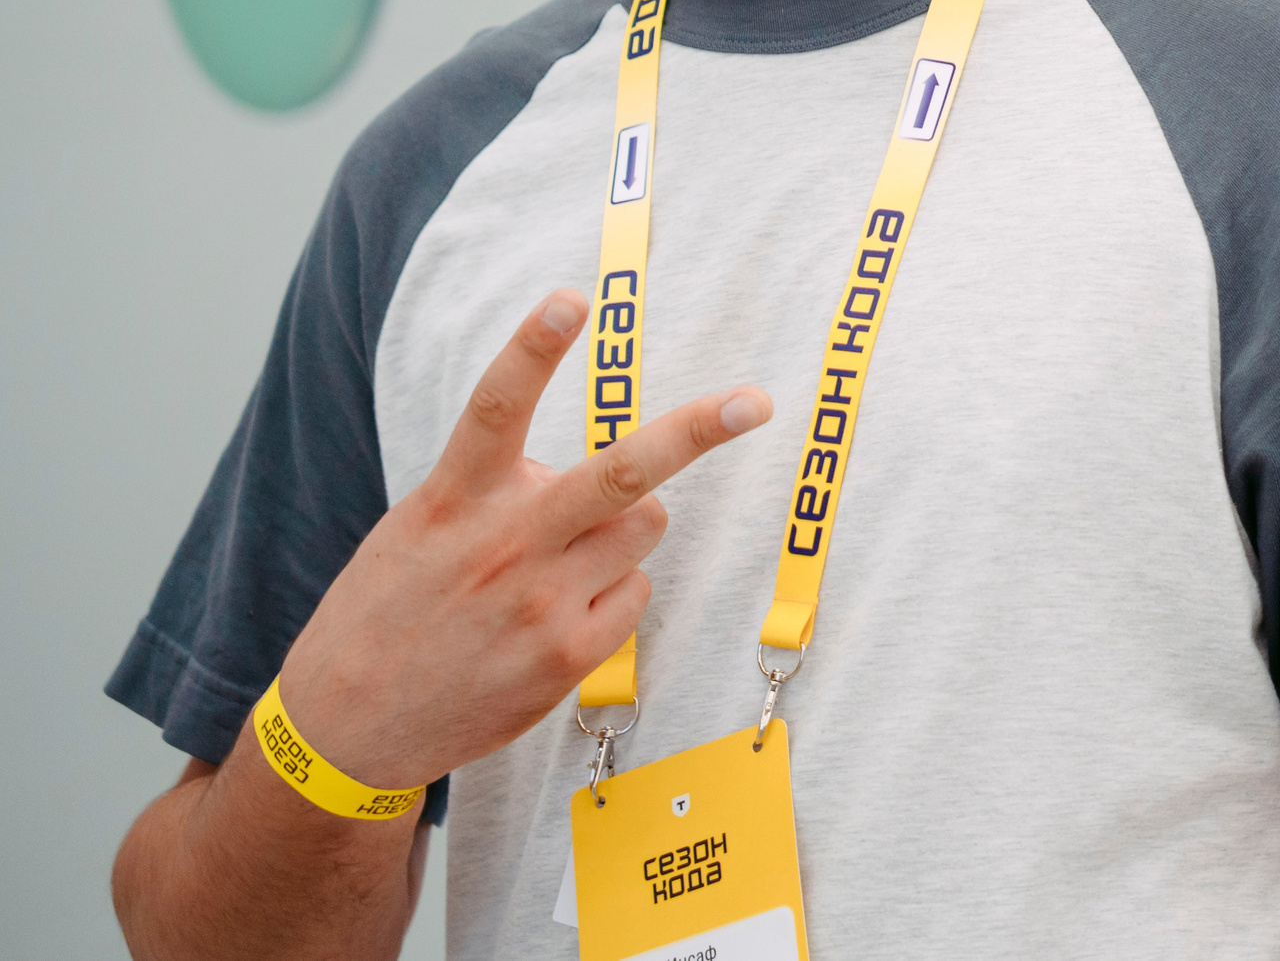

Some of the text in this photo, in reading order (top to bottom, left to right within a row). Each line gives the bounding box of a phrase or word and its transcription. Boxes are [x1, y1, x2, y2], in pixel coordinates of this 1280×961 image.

[788, 208, 905, 557] сезон кода
[643, 832, 728, 881] сезон
[653, 861, 722, 905] кода
